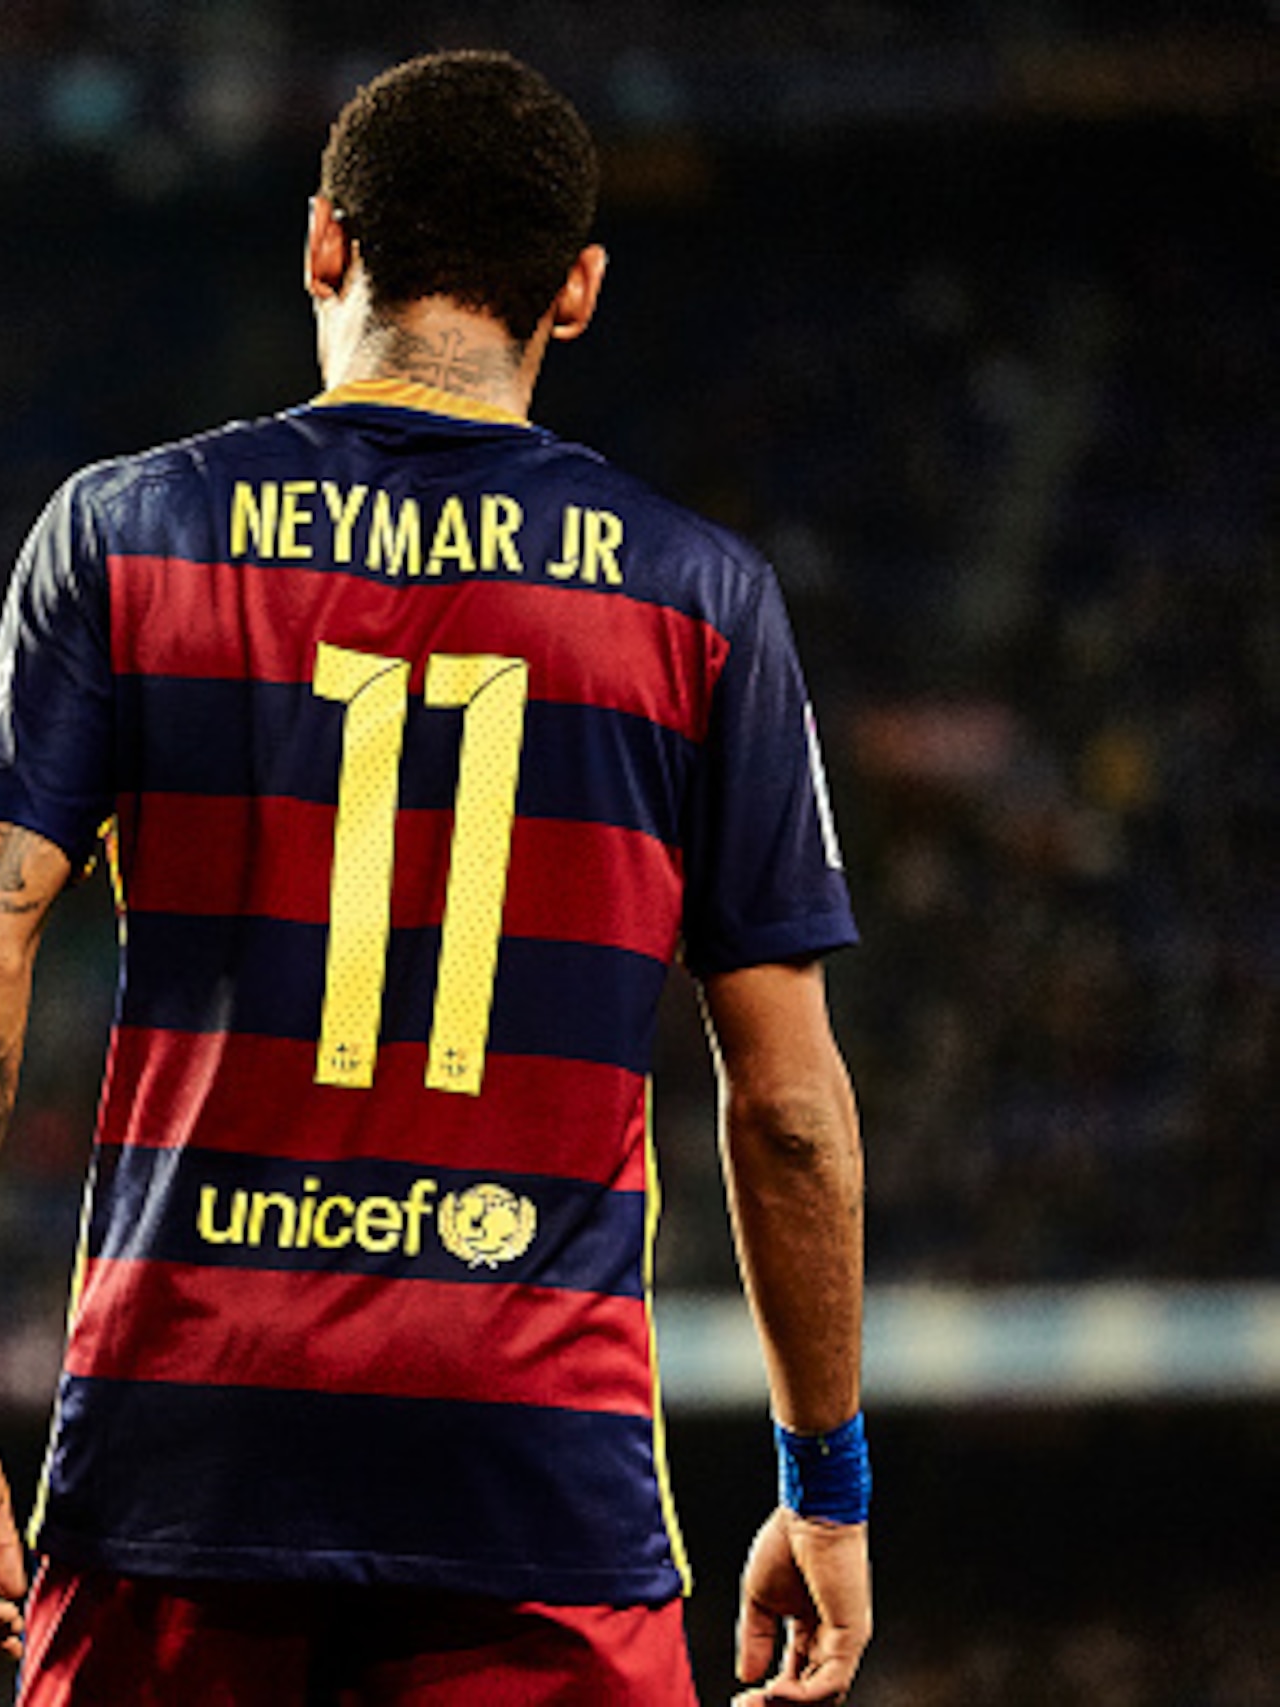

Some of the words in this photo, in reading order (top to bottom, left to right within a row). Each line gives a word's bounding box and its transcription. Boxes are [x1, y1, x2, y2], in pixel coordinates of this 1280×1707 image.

[230, 480, 522, 576] NEYMAR
[546, 506, 623, 585] JR
[312, 641, 528, 1096] 11
[197, 1177, 437, 1257] unicef
